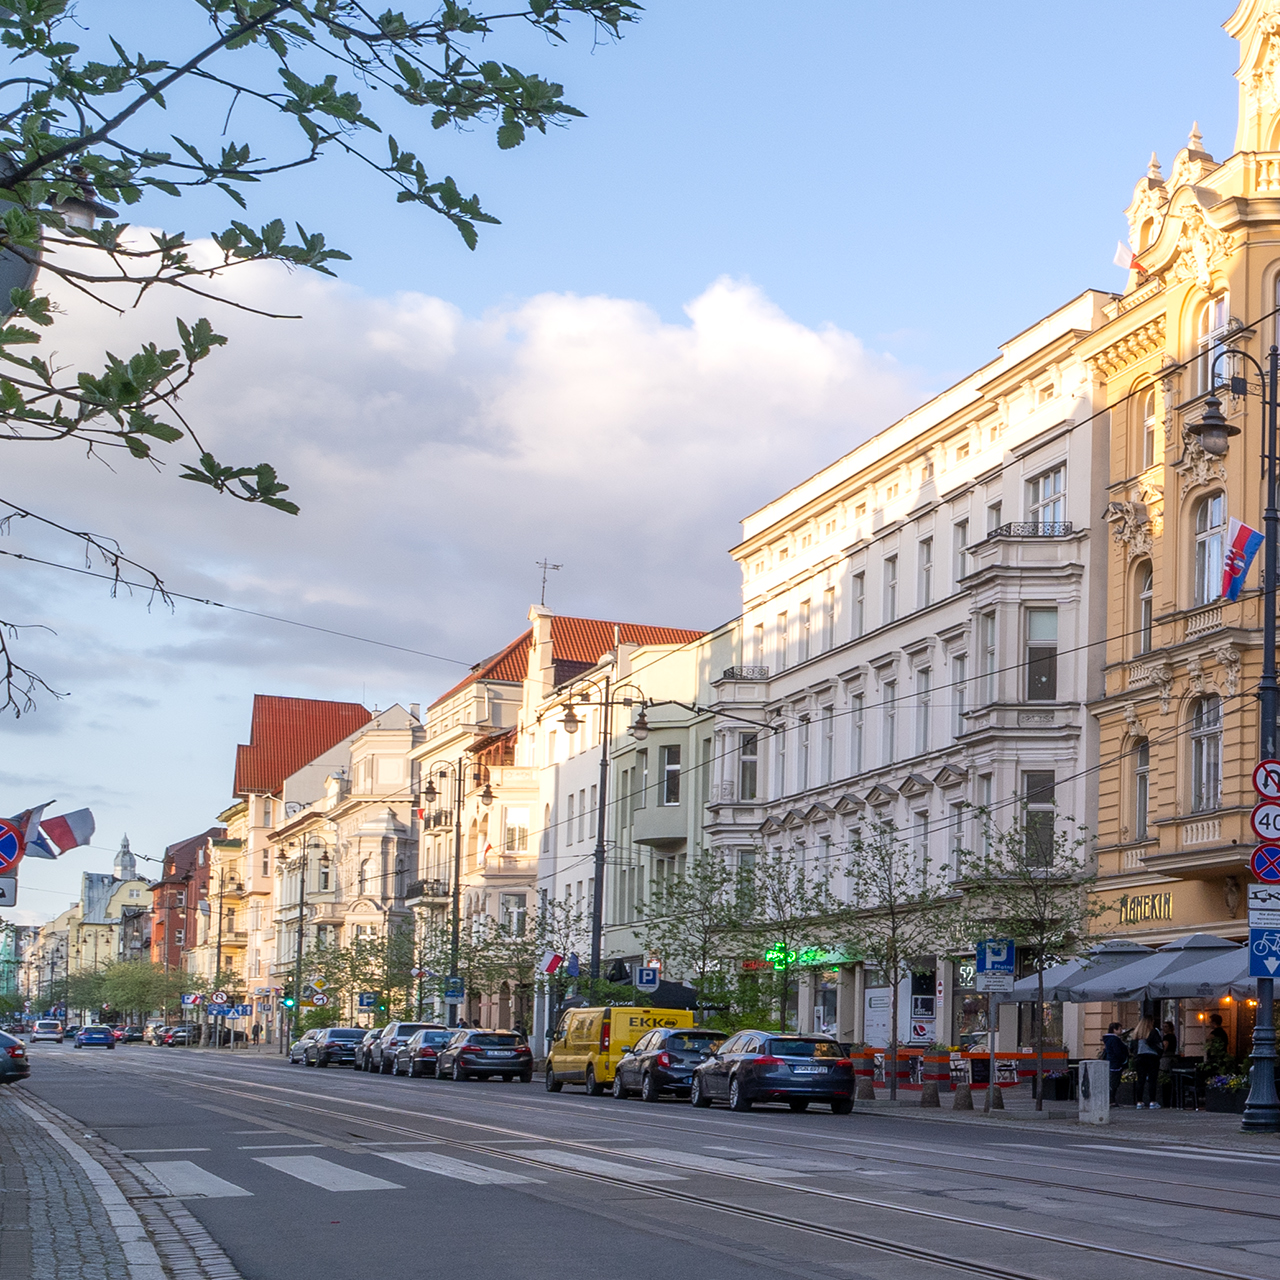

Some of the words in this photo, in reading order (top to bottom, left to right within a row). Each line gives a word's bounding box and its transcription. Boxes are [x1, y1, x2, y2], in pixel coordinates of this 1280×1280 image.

[1120, 892, 1173, 922] MANEKIN
[986, 942, 1007, 969] P
[643, 970, 654, 983] P
